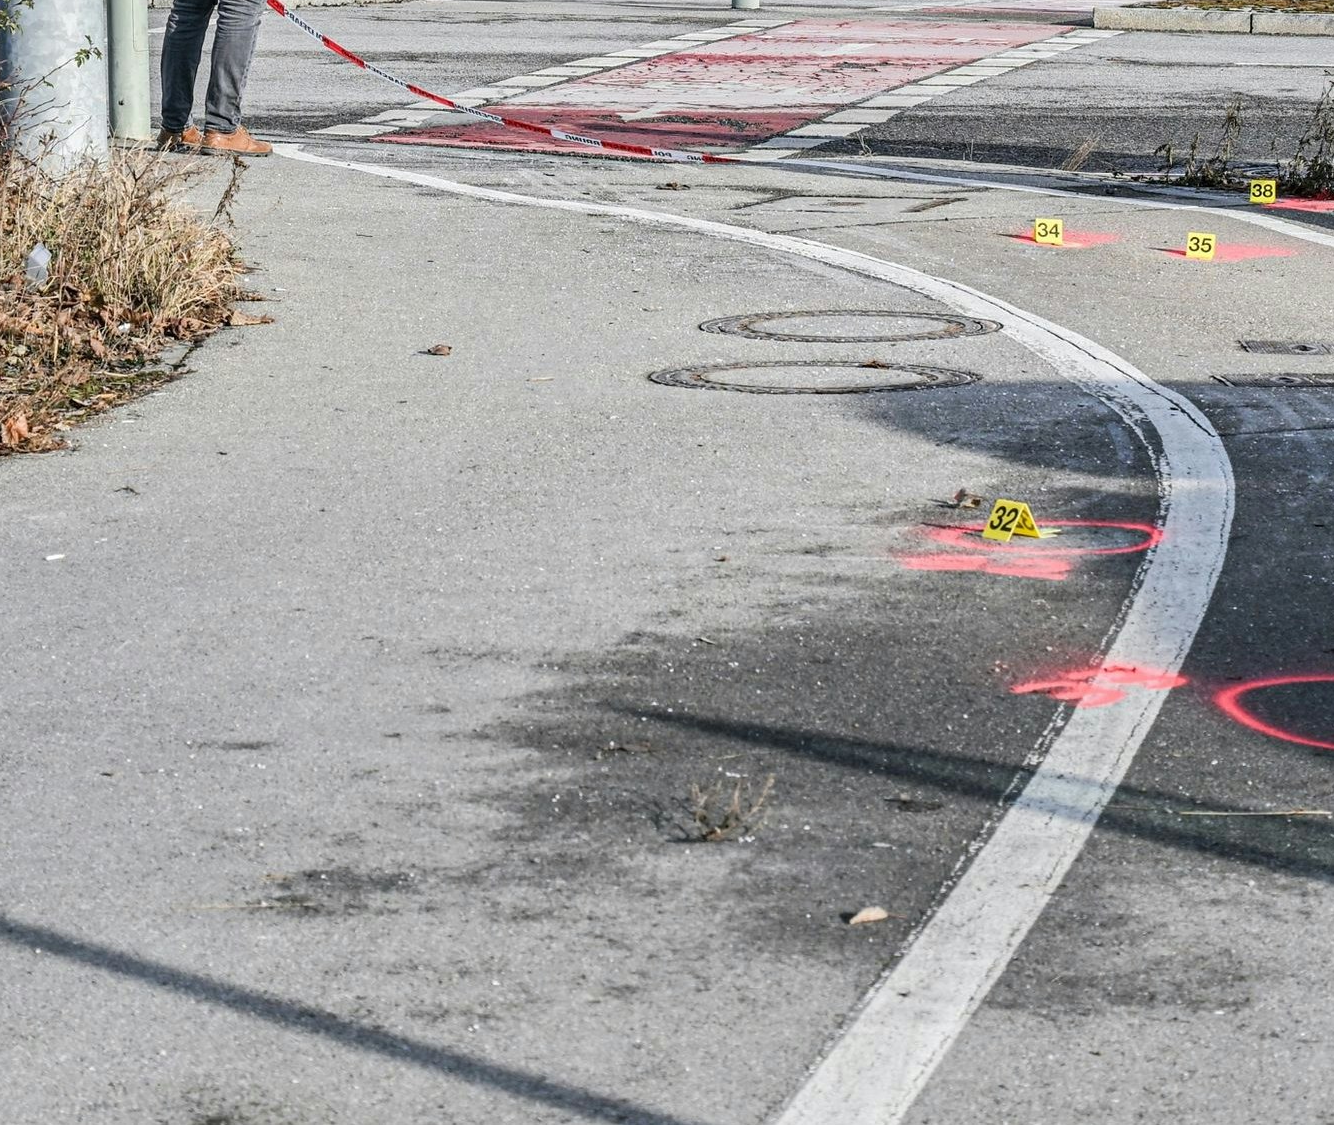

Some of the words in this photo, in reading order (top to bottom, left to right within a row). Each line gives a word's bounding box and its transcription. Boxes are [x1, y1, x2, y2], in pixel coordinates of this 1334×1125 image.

[1252, 183, 1274, 198] 38
[1037, 222, 1060, 238] 34
[1188, 236, 1212, 253] 35
[989, 505, 1019, 532] 32
